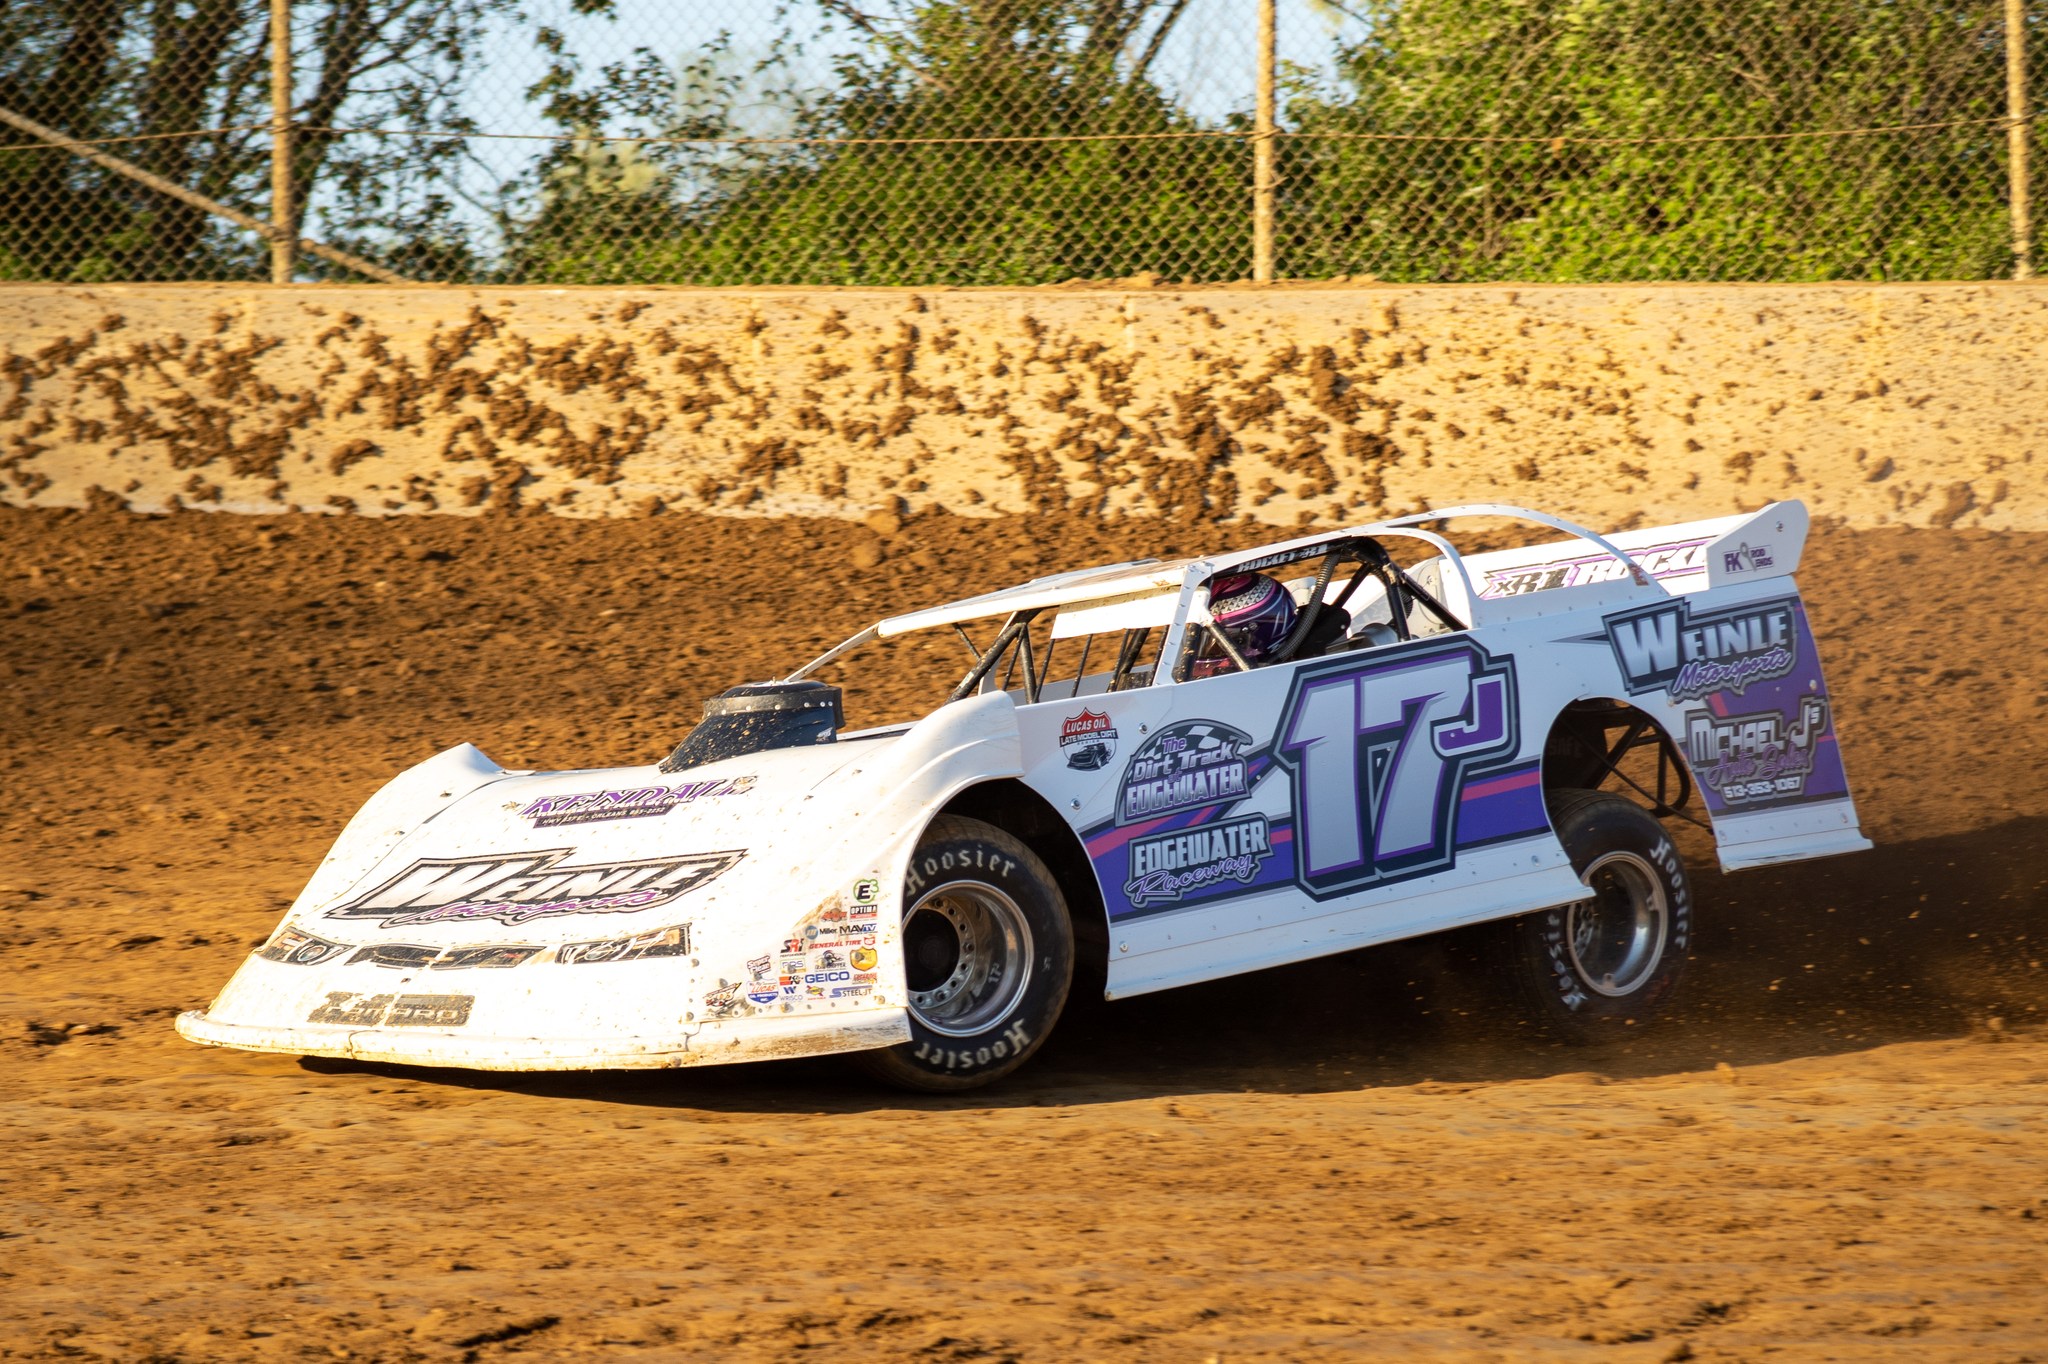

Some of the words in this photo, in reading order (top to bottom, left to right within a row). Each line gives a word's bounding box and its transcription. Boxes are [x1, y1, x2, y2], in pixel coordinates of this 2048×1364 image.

[1724, 552, 1744, 572] FK
[1612, 609, 1789, 679] WEINLE
[1672, 646, 1792, 694] Motorsports
[1060, 734, 1077, 746] LATE
[1077, 732, 1101, 741] MODEL
[1100, 729, 1116, 738] DIRT
[1066, 720, 1092, 733] LUCAS
[1093, 717, 1107, 729] OIL
[1163, 737, 1187, 753] The
[1691, 718, 1785, 762] MICHAEL
[1133, 757, 1173, 782] Dirt
[1178, 741, 1234, 770] Track
[1708, 749, 1756, 785] Auto
[1759, 742, 1810, 781] Sales
[1126, 763, 1245, 817] EDGEWATER
[905, 844, 1016, 897] Hoosier
[1135, 821, 1267, 877] EDGEWATER
[360, 860, 717, 908] WEINLE
[1128, 855, 1254, 902] Raceway
[851, 905, 878, 914] OPTIMA
[809, 941, 843, 949] GENERAL
[1548, 912, 1588, 1011] Hoosie
[751, 984, 776, 993] LUCAS
[805, 971, 850, 983] GEICO
[914, 1017, 1034, 1075] Hoosier
